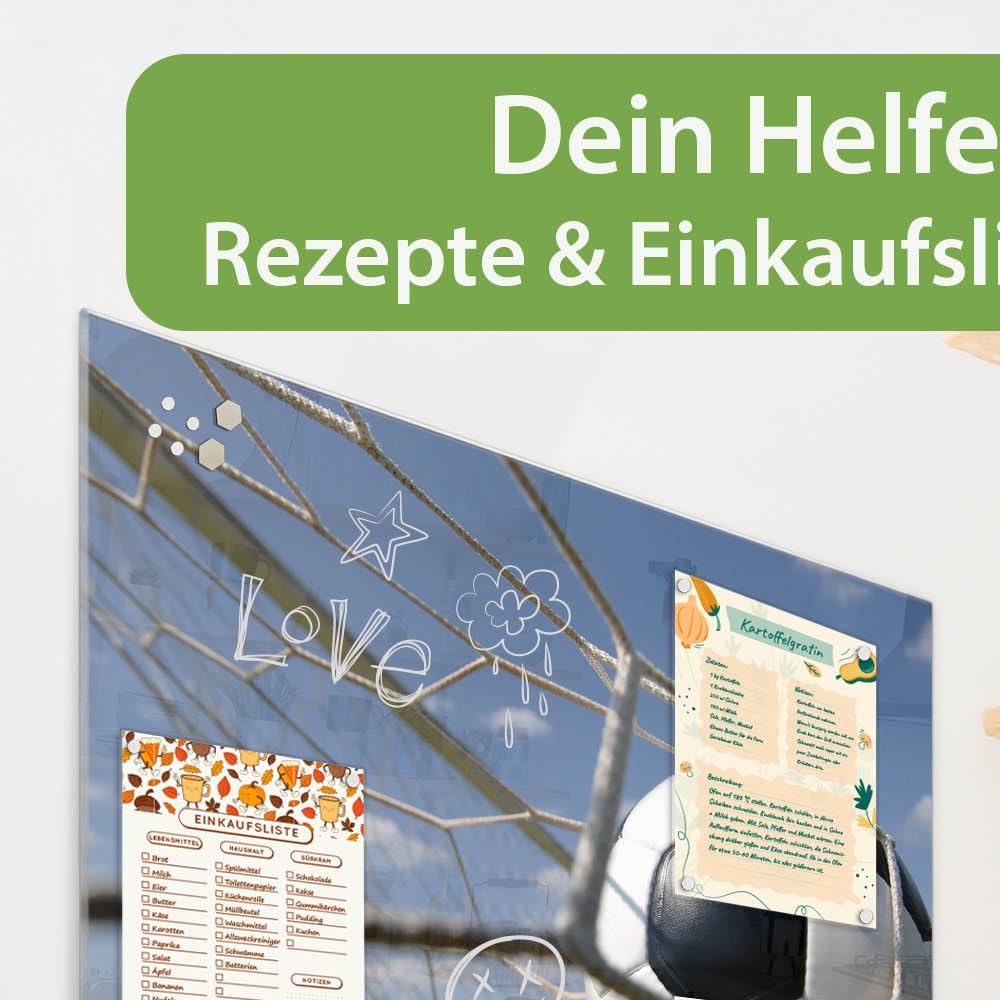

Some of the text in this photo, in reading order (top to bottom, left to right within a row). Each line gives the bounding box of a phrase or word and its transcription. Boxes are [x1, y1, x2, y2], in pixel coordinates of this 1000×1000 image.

[740, 618, 824, 658] Kartoffelgratin
[195, 815, 299, 837] EINKAUFSLISTE
[149, 834, 199, 846] LEBENSMITTEL
[229, 845, 264, 855] HAUSHALT
[152, 855, 169, 863] Brot
[152, 869, 171, 877] Milch
[225, 864, 260, 875] Spülmittel
[296, 873, 332, 883] Schokolade
[152, 883, 166, 891] Eier
[225, 879, 276, 891] Toilettenpapier
[296, 887, 314, 896] Kekse
[152, 897, 176, 906] Butter
[225, 893, 264, 903] Küchenrolle
[225, 906, 260, 915] Müllbeutel
[296, 914, 323, 924] Pudding
[225, 920, 267, 930] Waschmittel
[152, 926, 184, 934] Karotten
[296, 928, 320, 936] Kuchen
[225, 933, 280, 946] Allzweckreiniger
[152, 940, 180, 949] Paprika
[152, 954, 171, 962] Salat
[225, 962, 258, 970] Batterien
[152, 982, 183, 990] Bananen
